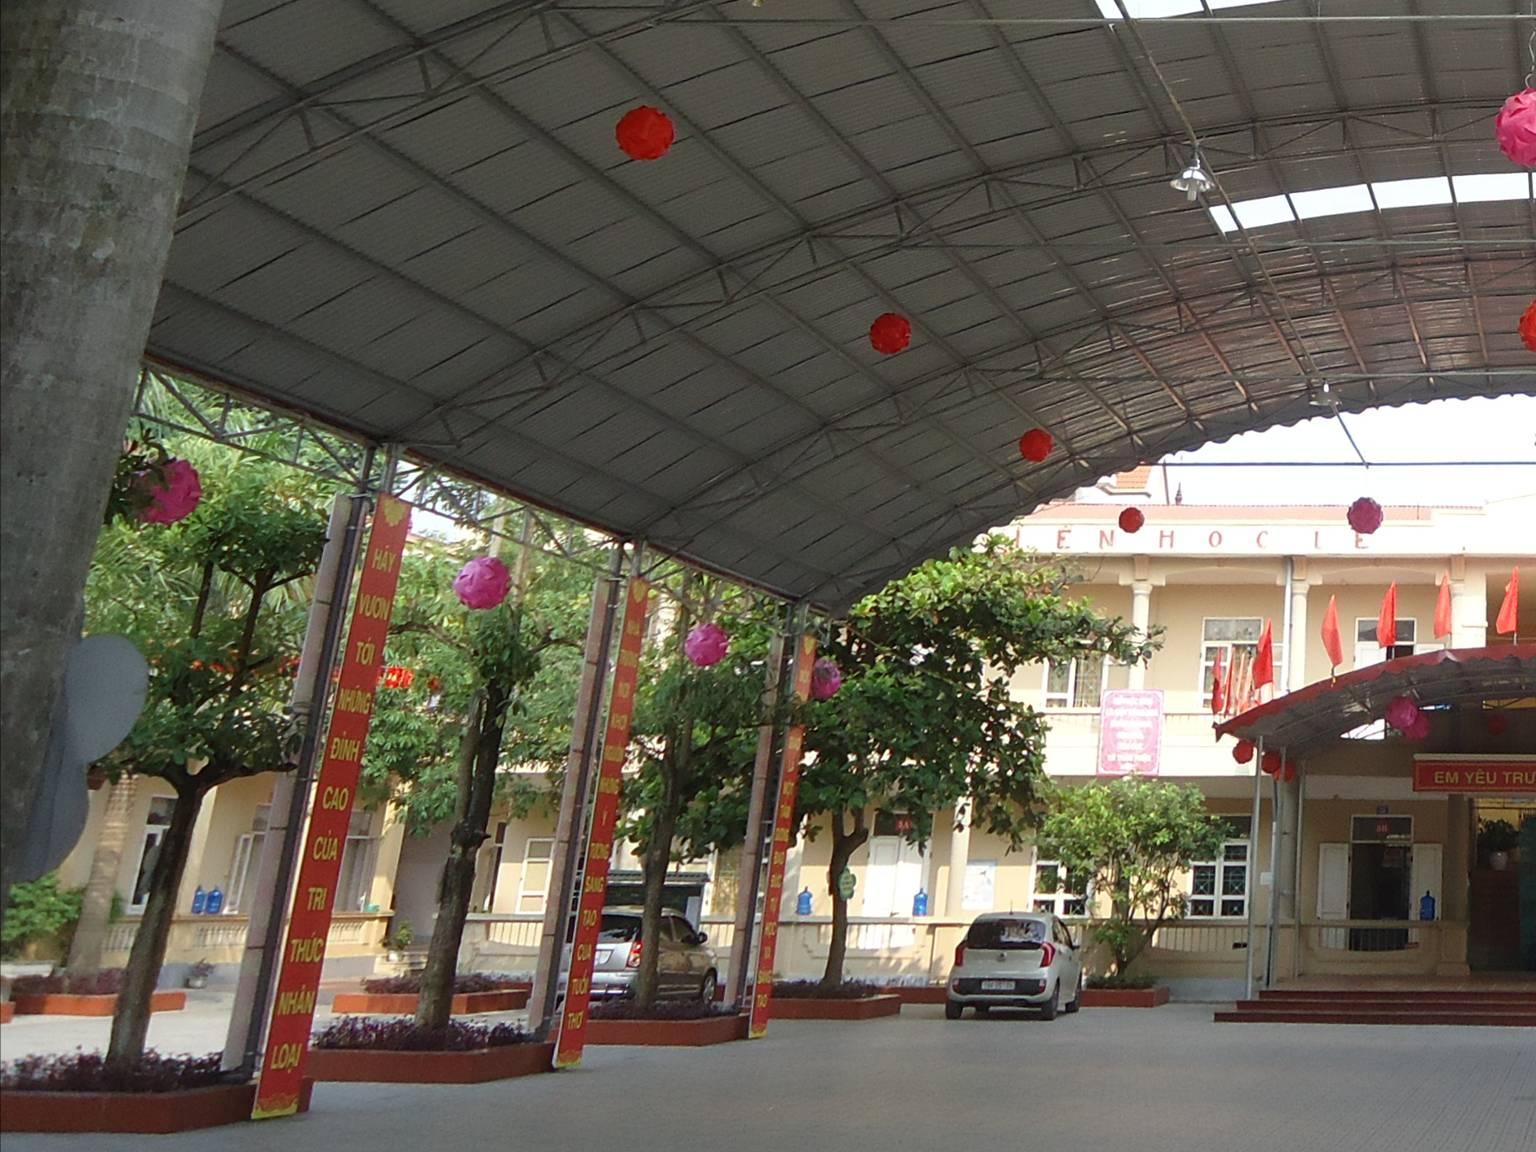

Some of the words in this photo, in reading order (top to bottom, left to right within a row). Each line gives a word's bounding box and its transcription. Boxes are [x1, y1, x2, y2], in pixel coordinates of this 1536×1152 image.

[1434, 771, 1459, 784] EM
[1465, 768, 1497, 784] YÊU
[323, 786, 349, 811] CAO
[307, 887, 327, 910] TRI
